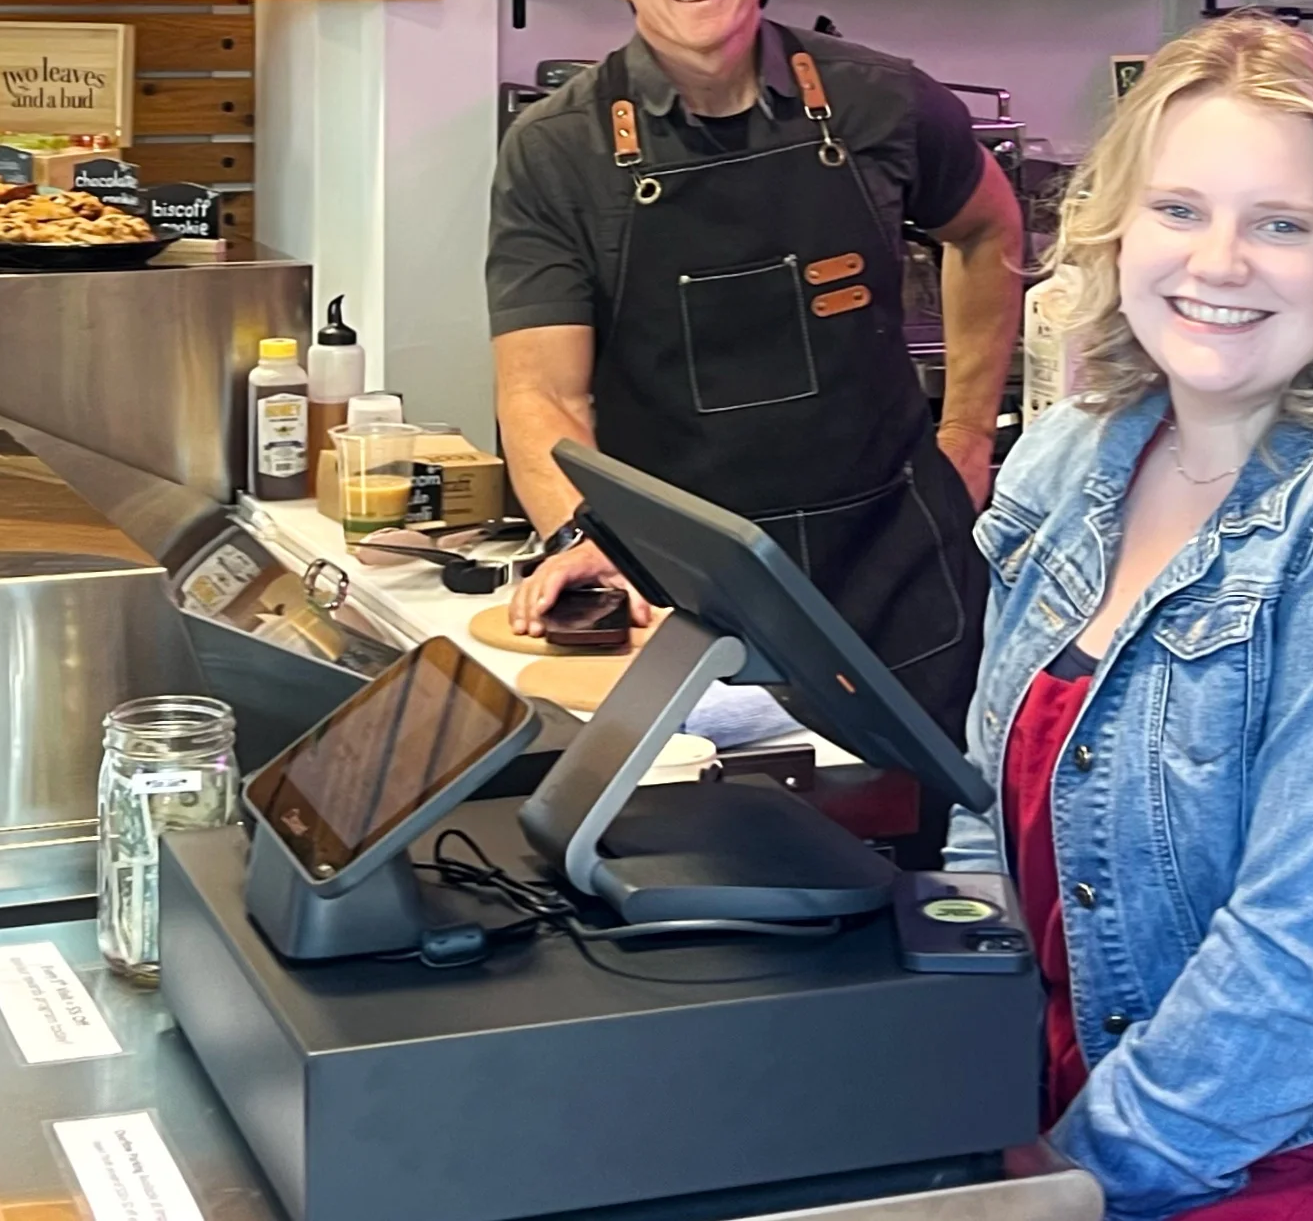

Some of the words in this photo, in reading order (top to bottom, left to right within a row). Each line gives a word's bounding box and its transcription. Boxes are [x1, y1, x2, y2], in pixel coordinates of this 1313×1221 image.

[42, 55, 107, 89] leaves
[11, 86, 44, 109] and
[46, 94, 57, 109] a
[60, 86, 94, 109] bud
[151, 198, 211, 218] biscoff
